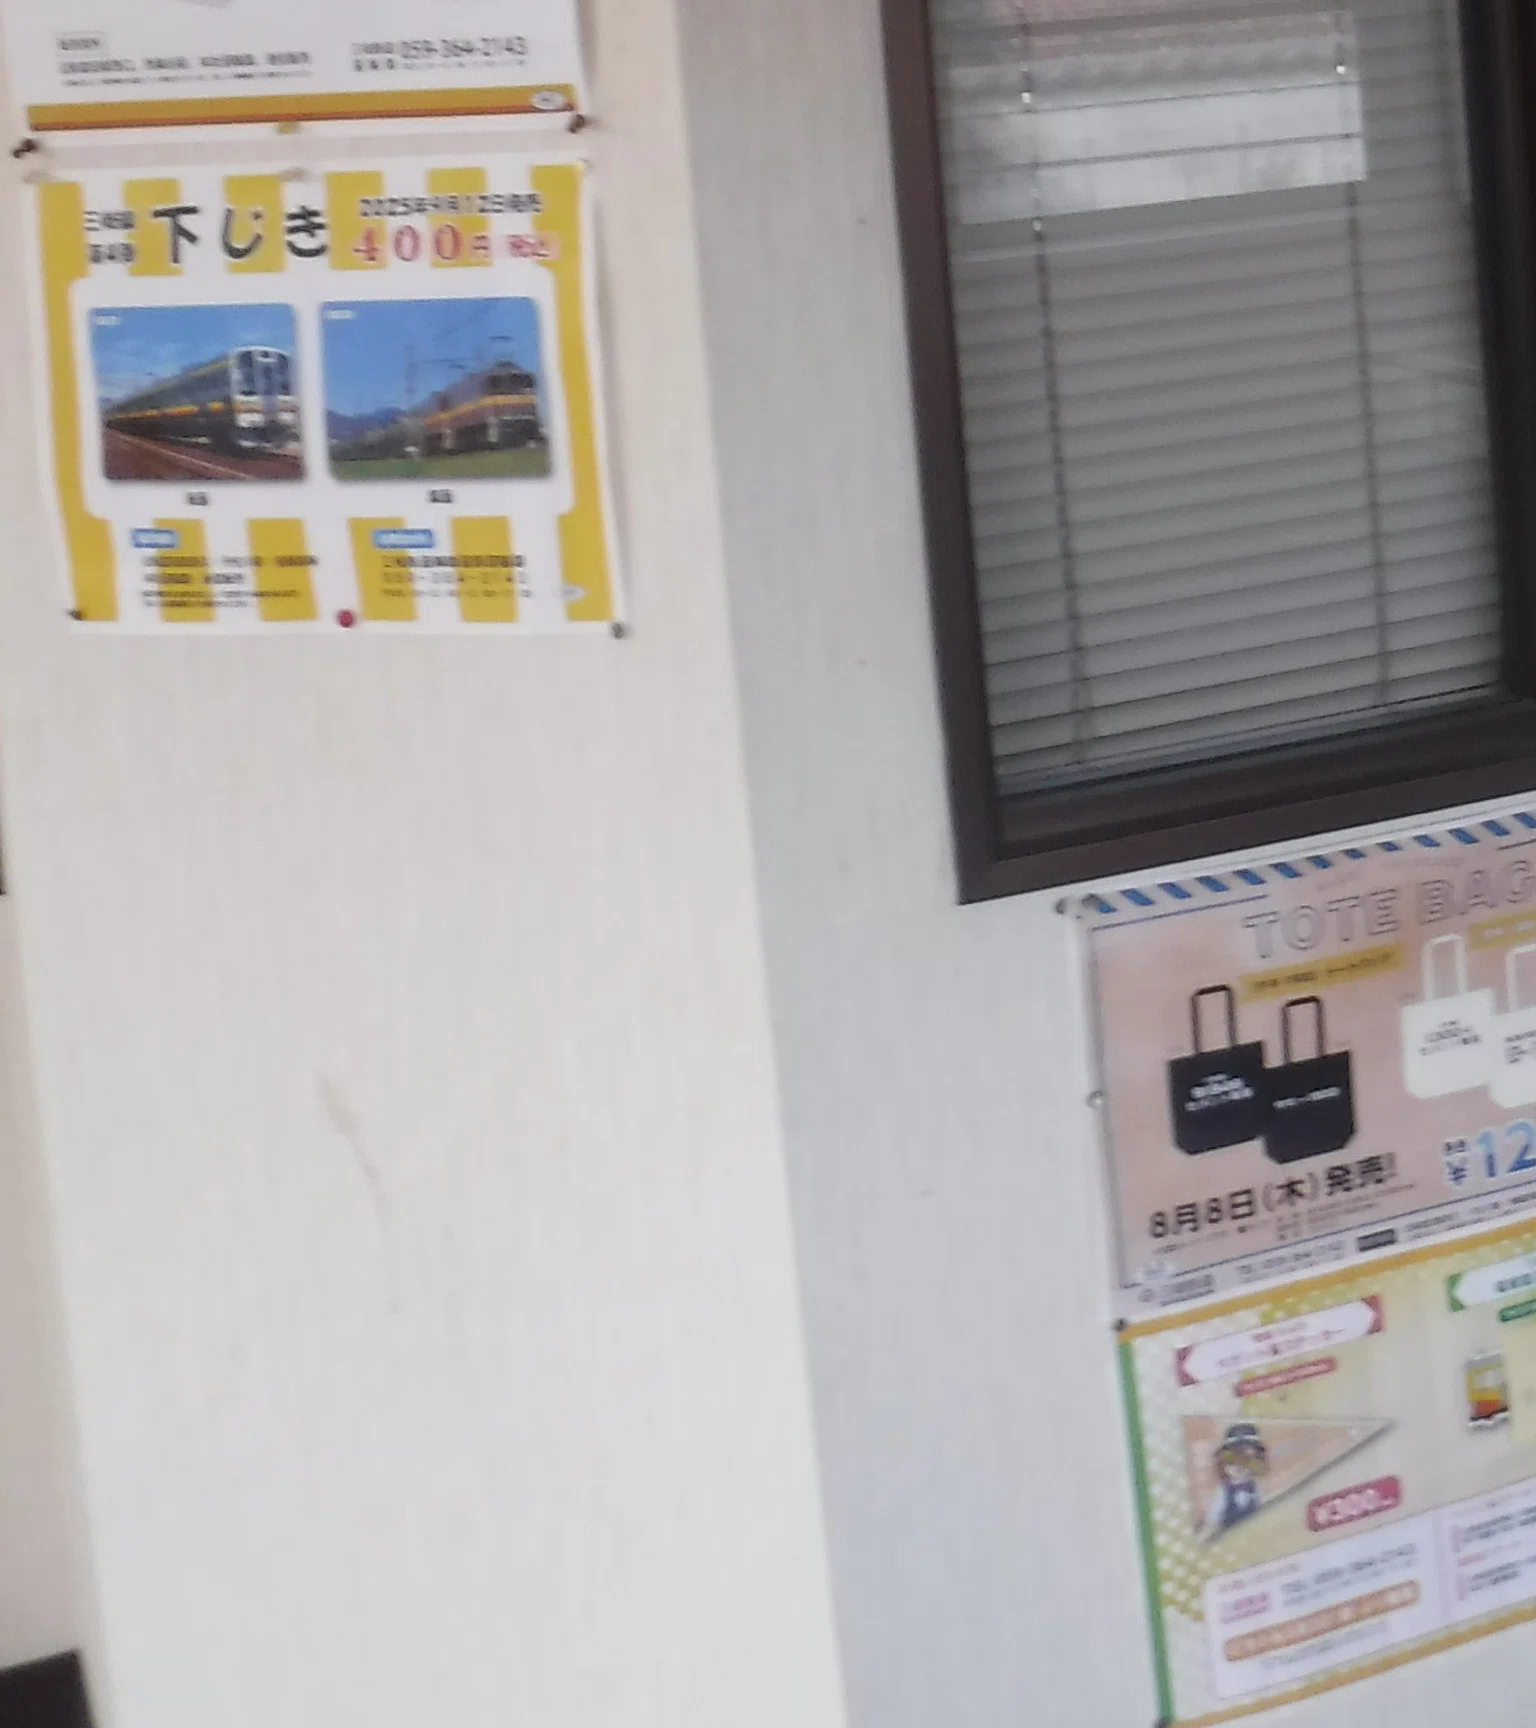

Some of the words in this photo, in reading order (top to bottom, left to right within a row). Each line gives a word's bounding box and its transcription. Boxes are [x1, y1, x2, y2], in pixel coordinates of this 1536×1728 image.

[152, 203, 329, 265] 下じき
[1242, 886, 1401, 959] TOTE
